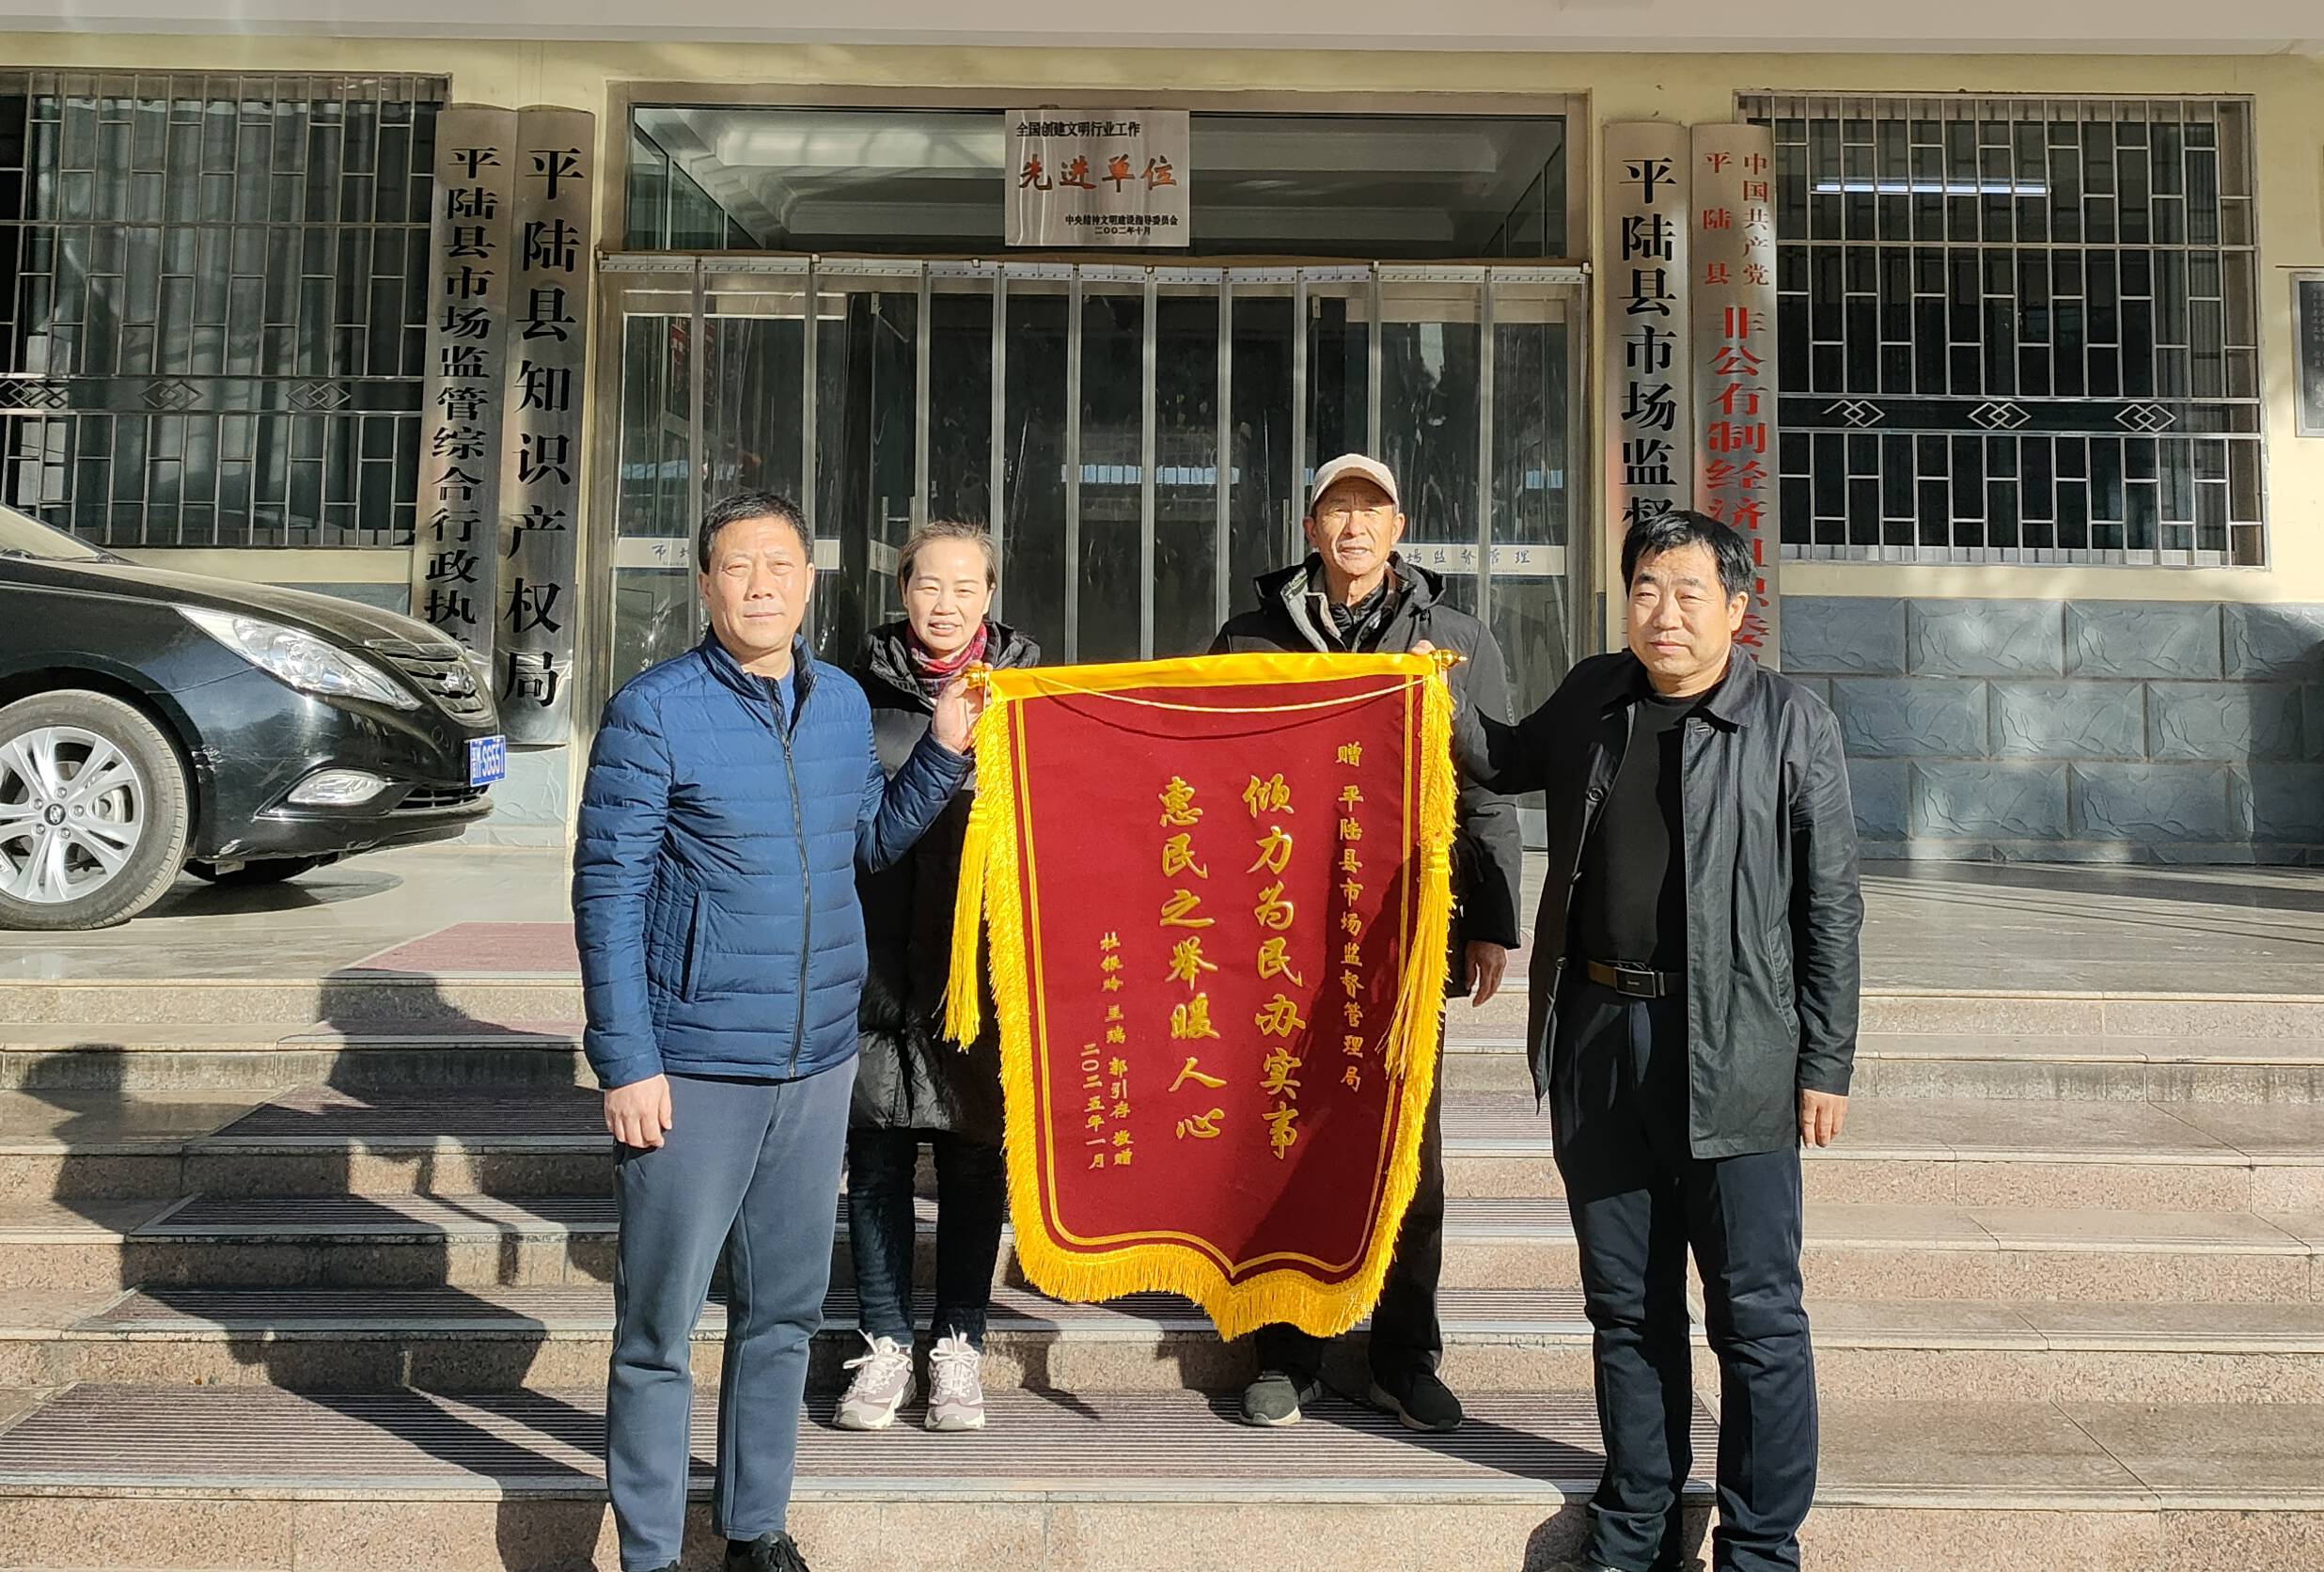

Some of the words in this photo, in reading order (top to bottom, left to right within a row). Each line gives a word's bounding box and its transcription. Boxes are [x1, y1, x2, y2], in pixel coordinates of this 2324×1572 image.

[1016, 121, 1140, 137] 全国创建文明行业工作
[1018, 153, 1177, 193] 先进单位
[1702, 151, 1733, 286] 平陆县
[1742, 153, 1770, 286] 中国共产党
[424, 147, 501, 651] 平陆县市场监管综合行政执
[502, 148, 584, 707] 平陆县知识产权局
[1158, 776, 1227, 1140] 惠民之举暖人心
[1242, 773, 1307, 1160] 倾力为民办实事
